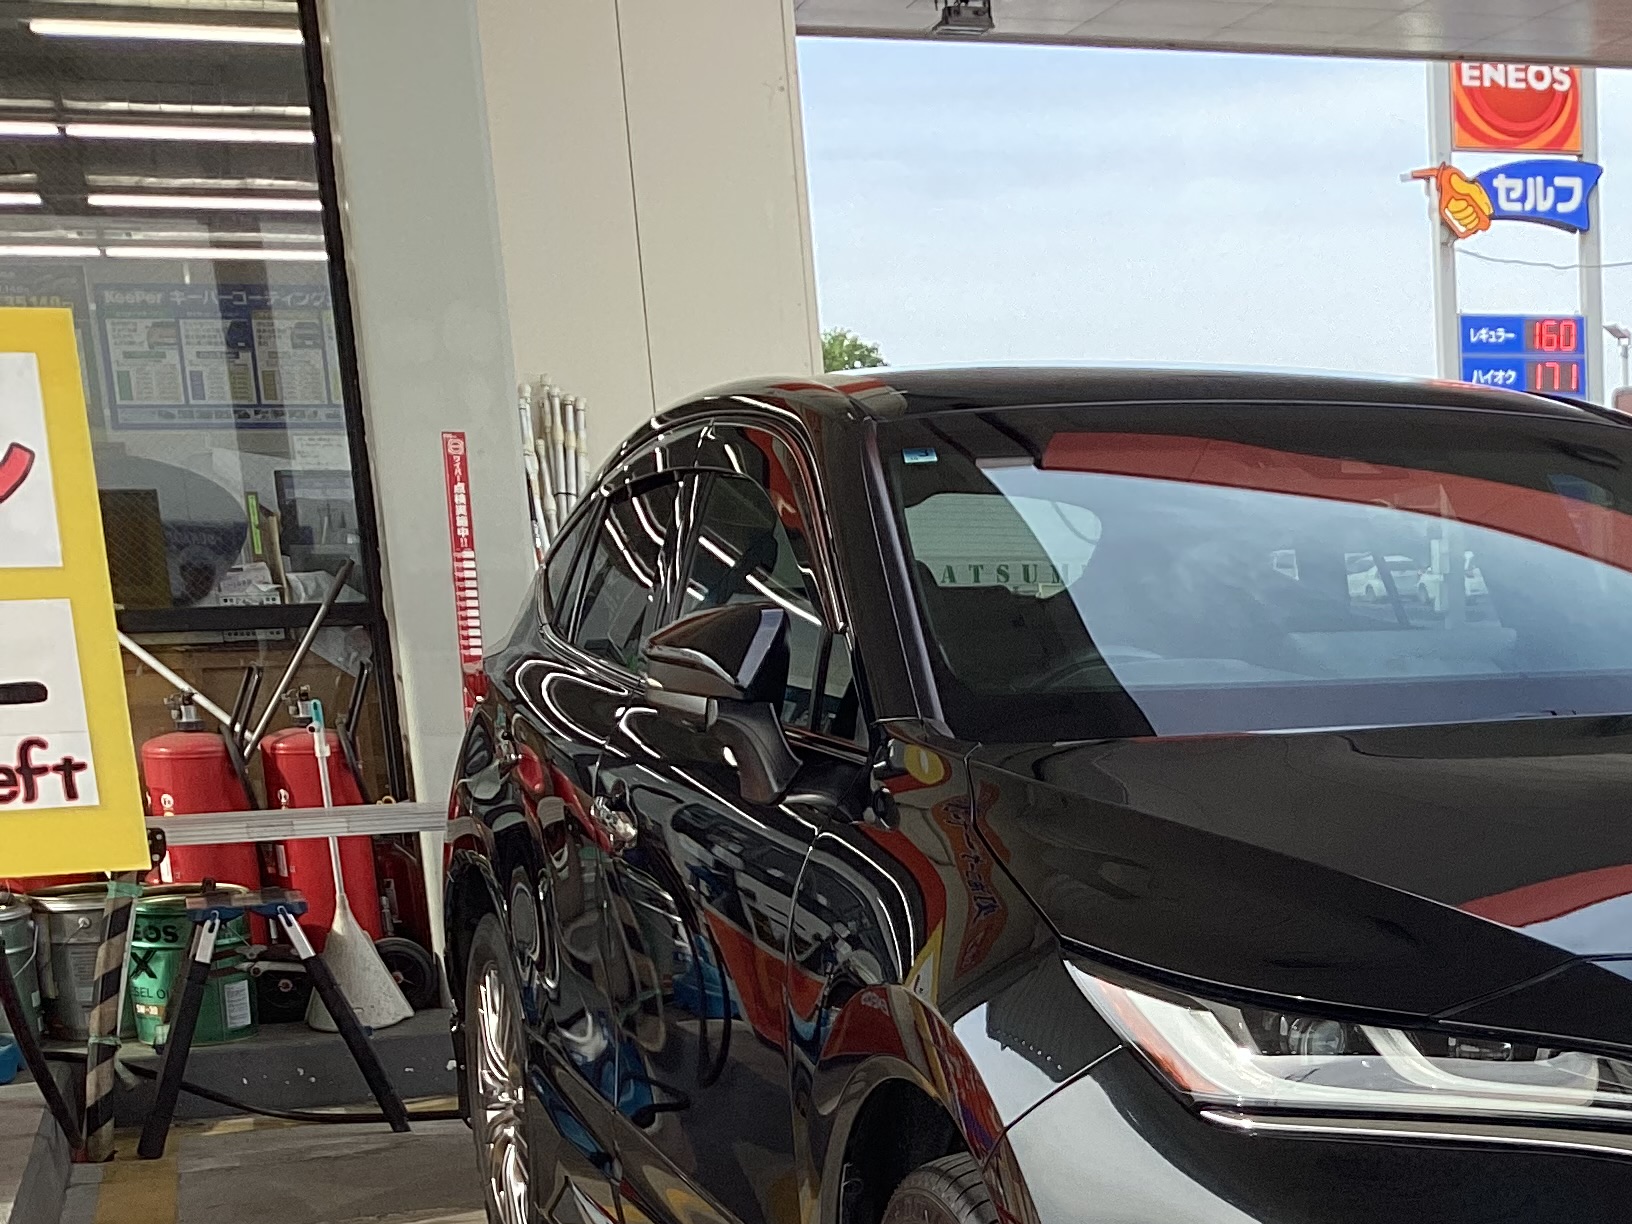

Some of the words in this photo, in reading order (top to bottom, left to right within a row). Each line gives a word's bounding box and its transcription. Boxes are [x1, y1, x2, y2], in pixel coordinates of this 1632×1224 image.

[1460, 63, 1572, 92] ENEOS
[1492, 173, 1584, 214] セルフ
[1469, 327, 1516, 343] レギュラー
[1533, 319, 1578, 351] 160
[1471, 367, 1517, 388] ハイオク
[1535, 361, 1578, 391] 171
